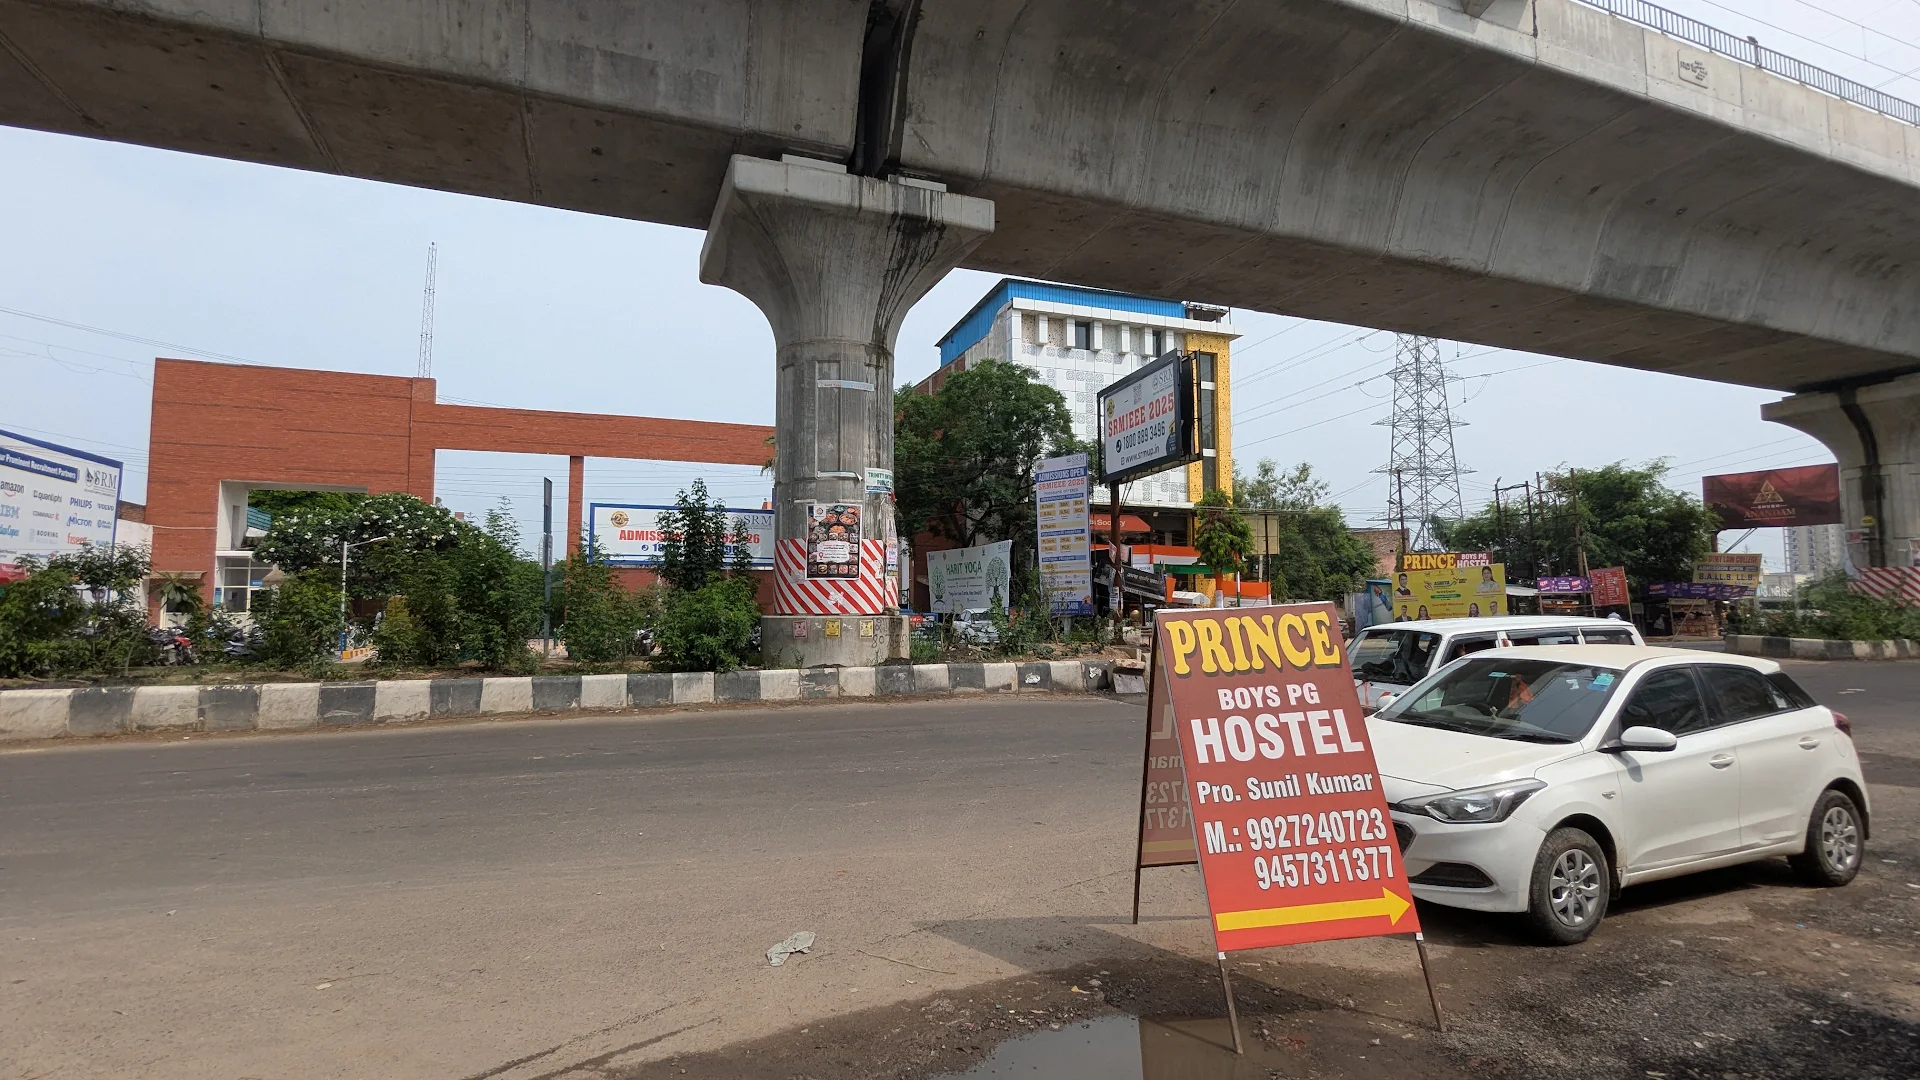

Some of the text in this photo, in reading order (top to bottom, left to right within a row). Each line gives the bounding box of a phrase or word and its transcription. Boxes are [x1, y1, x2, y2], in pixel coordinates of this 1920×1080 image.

[1149, 392, 1174, 420] 2025
[1123, 420, 1166, 450] 1800 889 3496
[31, 460, 59, 474] Recruitment
[59, 467, 77, 480] Partners
[1039, 467, 1084, 481] ADMISSIONS OPEN
[0, 480, 25, 493] amazon
[94, 470, 118, 489] SRM
[1067, 478, 1085, 487] 2025
[0, 504, 20, 518] IBM
[70, 497, 93, 509] PHILIPS
[67, 512, 92, 527] Micron
[744, 515, 773, 526] SRM
[1743, 508, 1796, 518] ANANDAM
[37, 530, 59, 538] BOOKING
[1403, 553, 1456, 570] PRINCE
[1736, 555, 1758, 563] COLLEGE
[945, 560, 983, 576] HARIT YOGA
[1165, 611, 1341, 677] PRINCE
[1218, 682, 1321, 710] BOYS PG
[1190, 708, 1365, 764] HOSTEL
[1196, 781, 1242, 804] Pro.
[1246, 774, 1301, 801] Sunil
[1305, 772, 1373, 796] Kumar
[1203, 807, 1387, 854] M.: 9927240723
[1254, 845, 1394, 890] 9457311377
